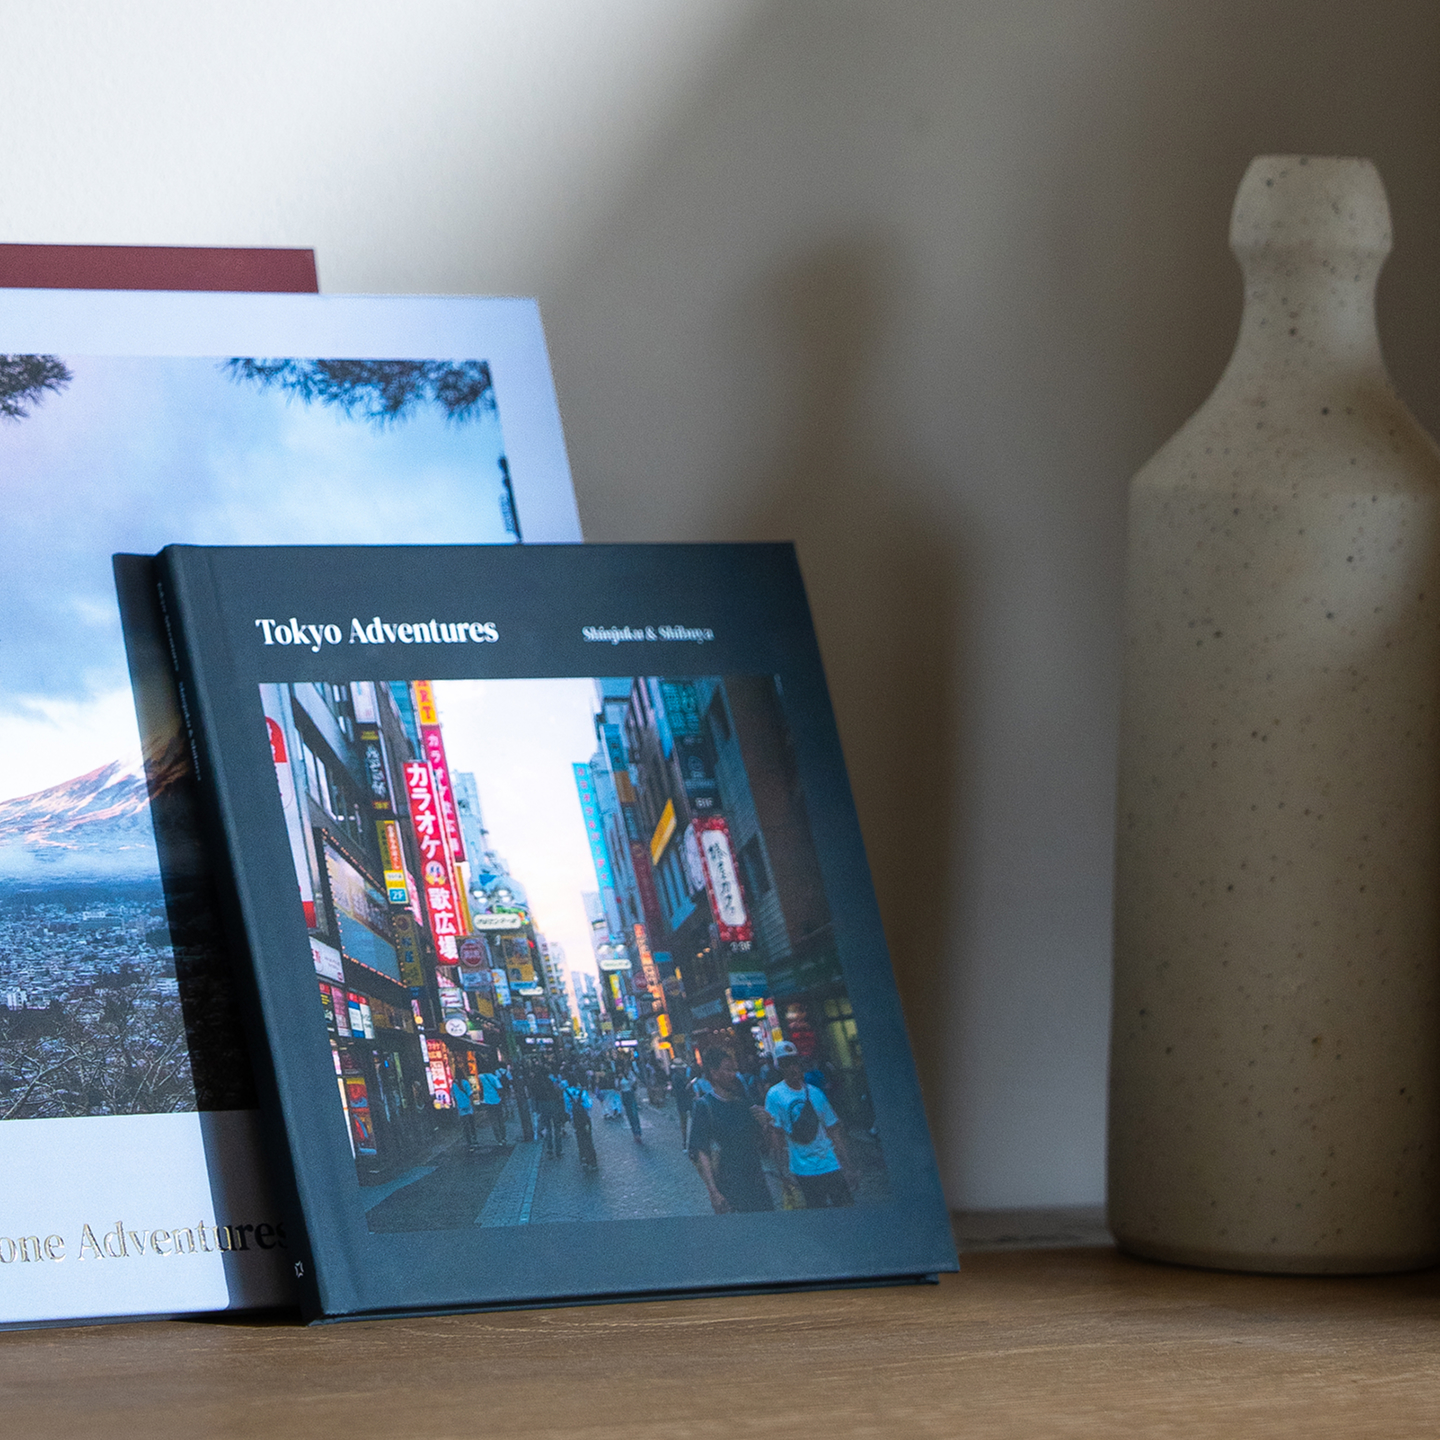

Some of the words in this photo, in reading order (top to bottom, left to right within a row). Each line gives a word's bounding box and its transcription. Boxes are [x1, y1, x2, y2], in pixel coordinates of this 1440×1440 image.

[255, 618, 342, 652] Tokyo
[348, 616, 500, 644] Adventures
[582, 626, 644, 645] Shinjuku
[645, 625, 658, 641] &
[658, 625, 715, 645] Shibuya
[407, 763, 441, 859] カラオケ
[427, 886, 459, 960] 歌広場
[392, 890, 404, 900] 2F
[78, 1220, 288, 1262] Adventures
